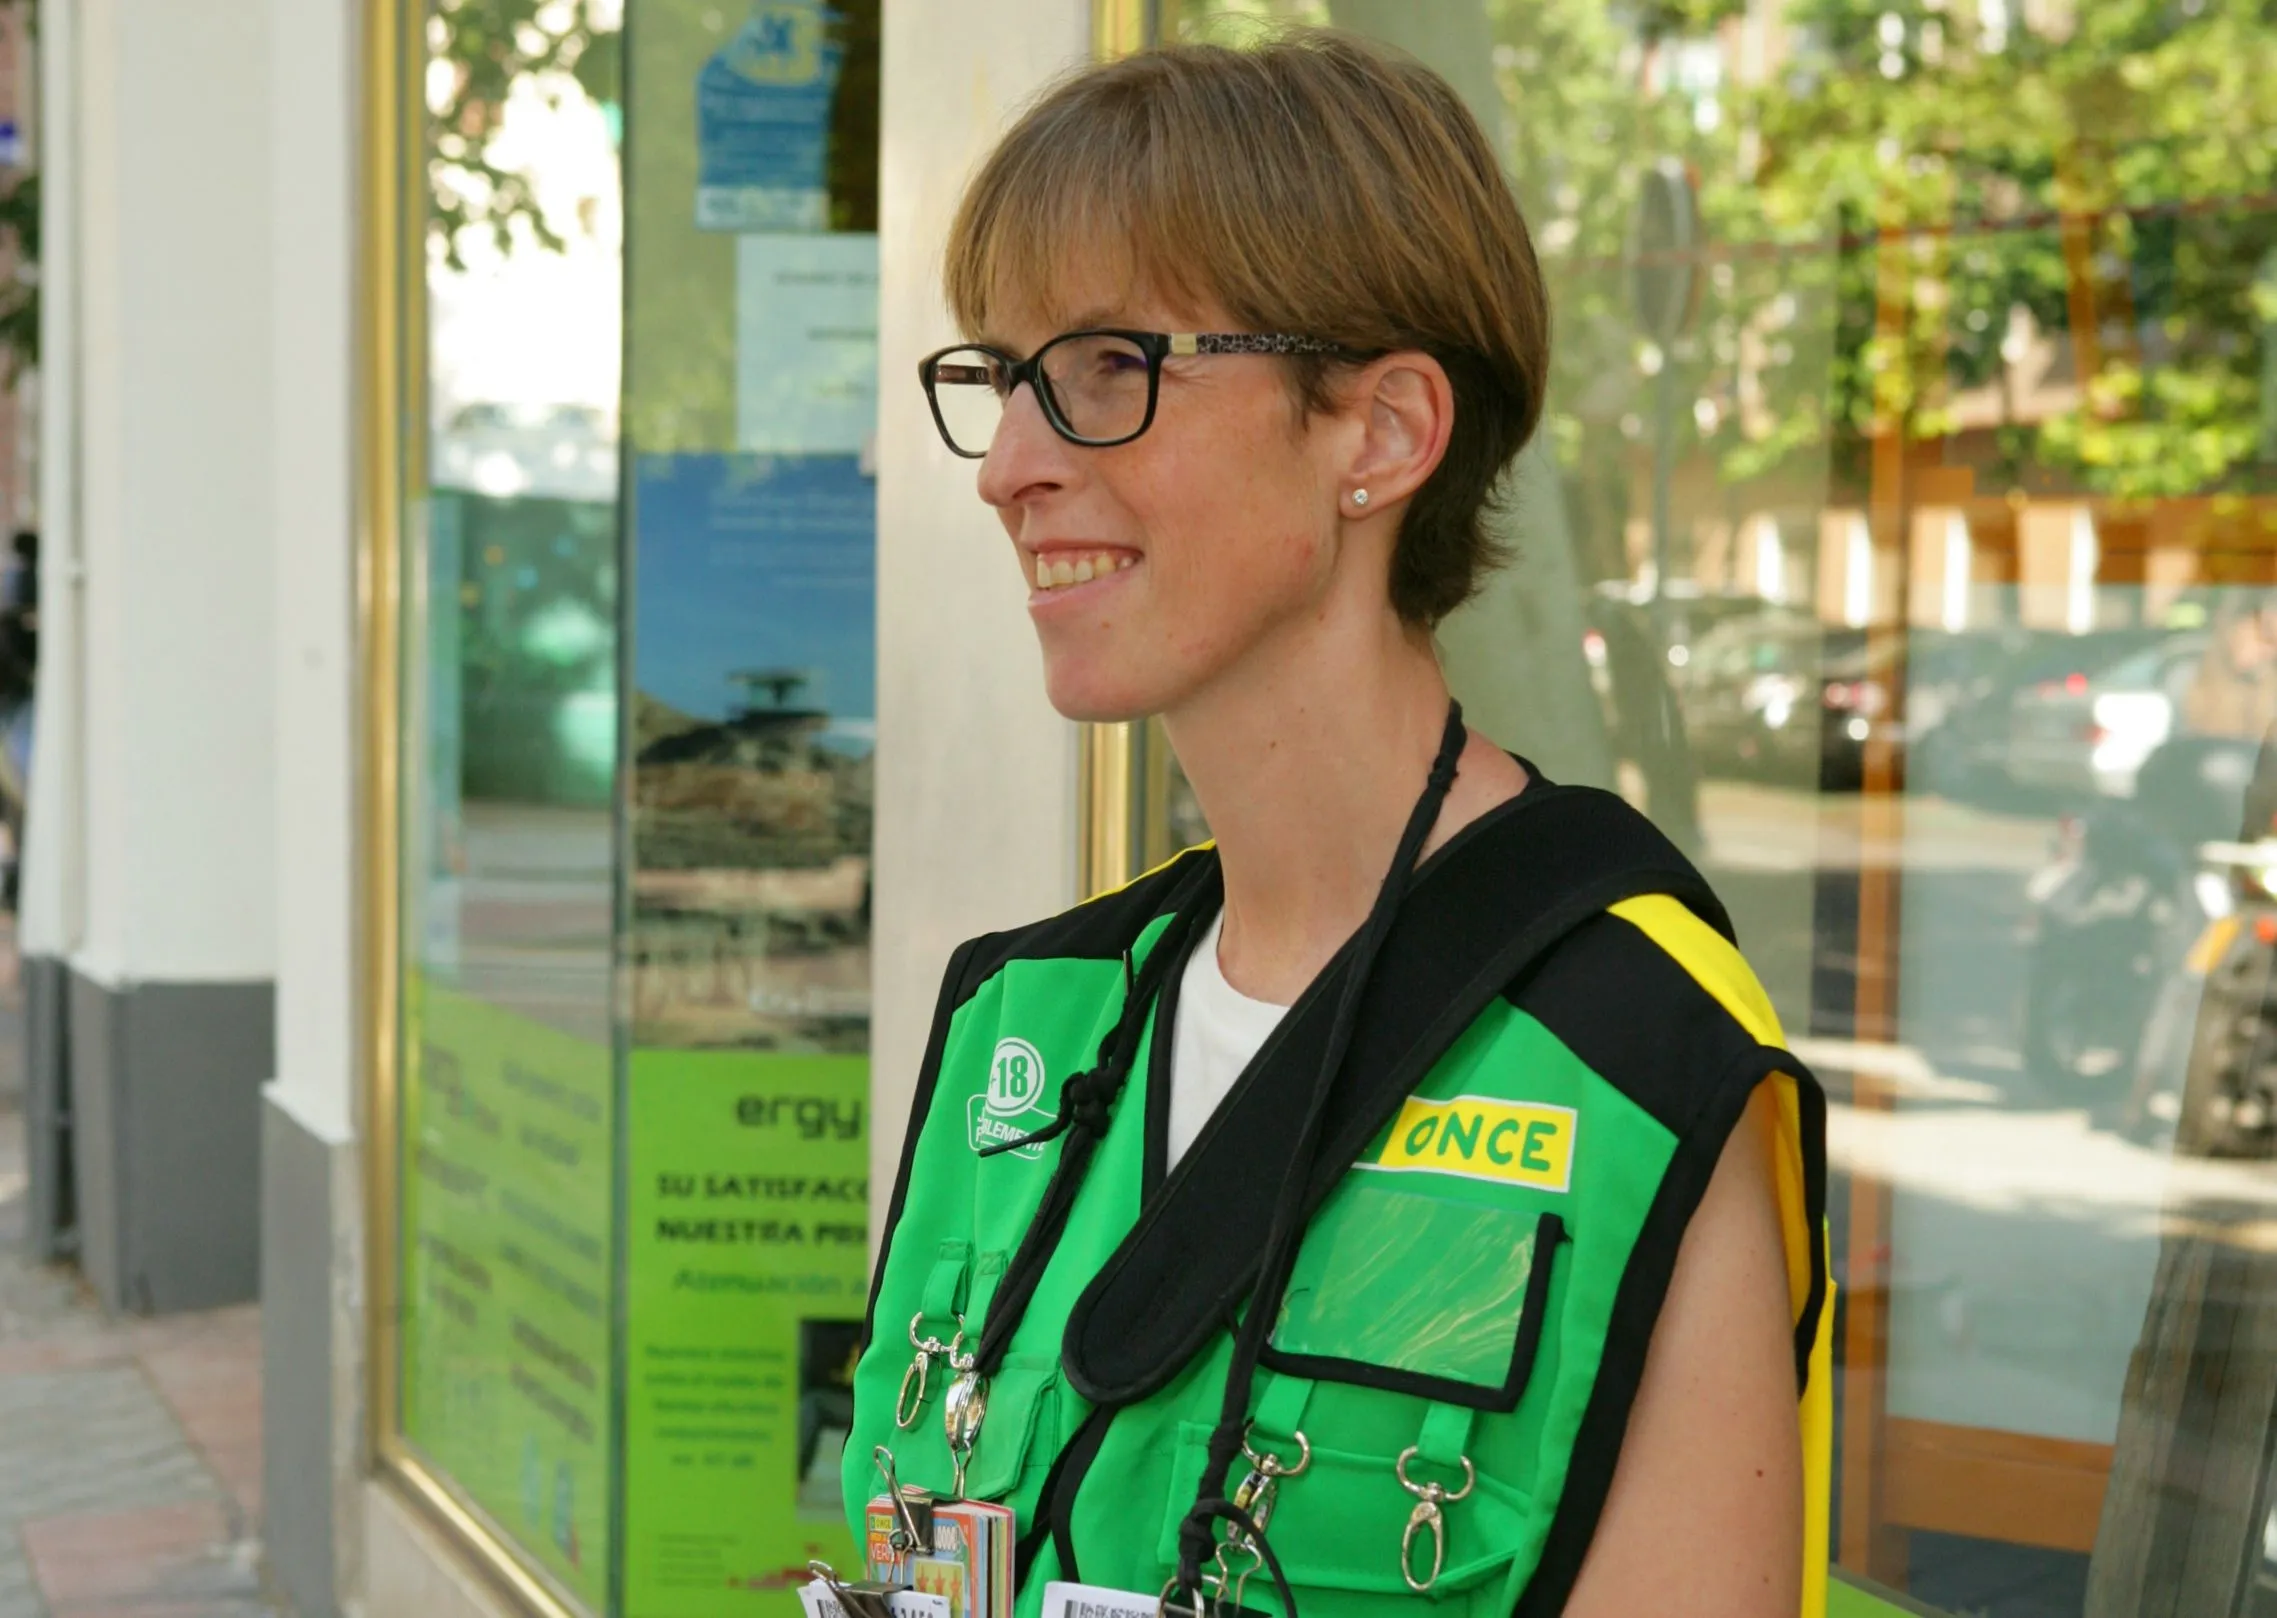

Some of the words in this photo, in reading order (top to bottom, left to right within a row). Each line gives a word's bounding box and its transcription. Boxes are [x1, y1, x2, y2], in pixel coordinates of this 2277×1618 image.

[1404, 1110, 1558, 1172] ONCE
[657, 1173, 694, 1197] SU
[655, 1218, 804, 1243] NUESTRA
